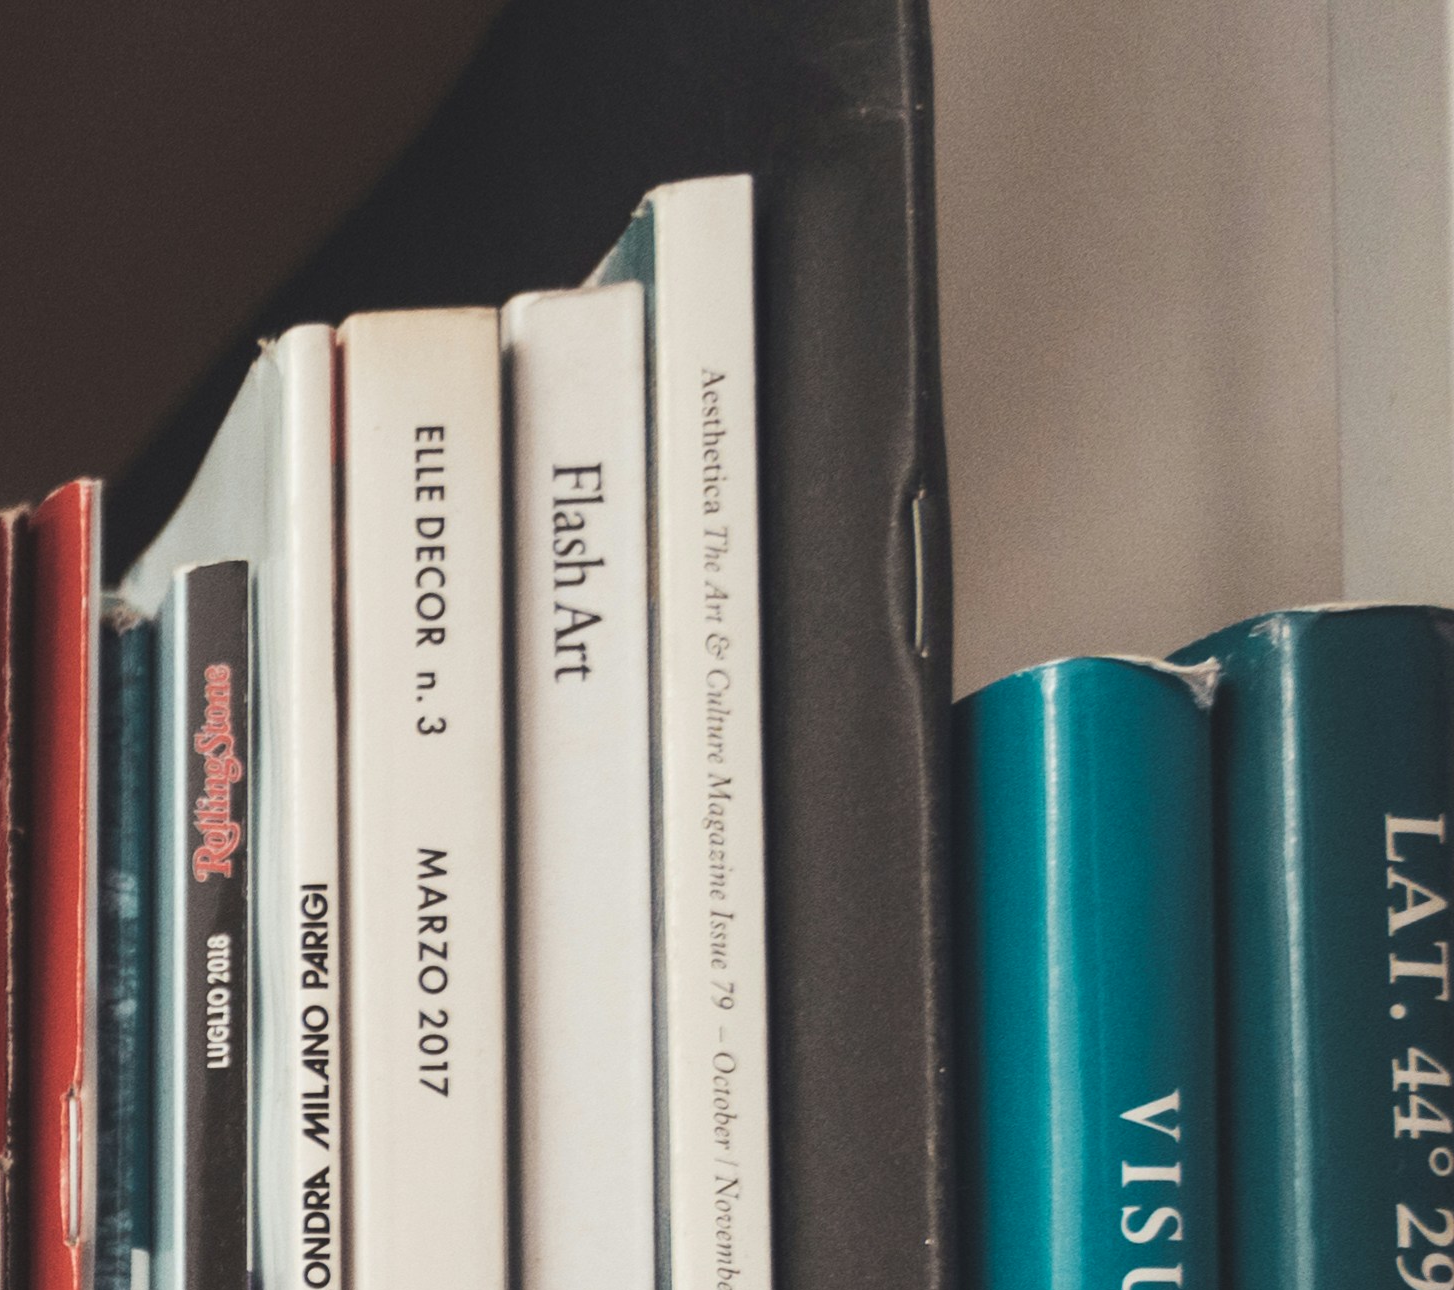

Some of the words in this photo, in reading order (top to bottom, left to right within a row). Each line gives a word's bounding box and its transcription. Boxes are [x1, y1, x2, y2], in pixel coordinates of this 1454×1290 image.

[414, 424, 445, 502] ELLE
[700, 368, 728, 515] Aesthetica
[552, 462, 605, 590] Flash
[703, 526, 729, 572] The
[414, 515, 447, 647] DECOR
[703, 579, 730, 623] Art
[415, 670, 437, 702] n.
[553, 601, 605, 684] Art
[704, 631, 730, 661] &
[415, 715, 447, 736] 3
[705, 667, 732, 764] Culture
[702, 772, 733, 900] Magazine
[206, 933, 233, 984] 2018
[299, 882, 329, 990] PARIGI
[416, 847, 449, 995] MARZO
[708, 909, 735, 970] Issue
[1382, 811, 1447, 1021] LAT.
[206, 987, 233, 1071] LUGLIO
[713, 981, 735, 1011] 79
[300, 1003, 330, 1151] MILANO
[417, 1008, 449, 1097] 2017
[711, 1050, 738, 1150] October
[1391, 1044, 1454, 1178] 44°
